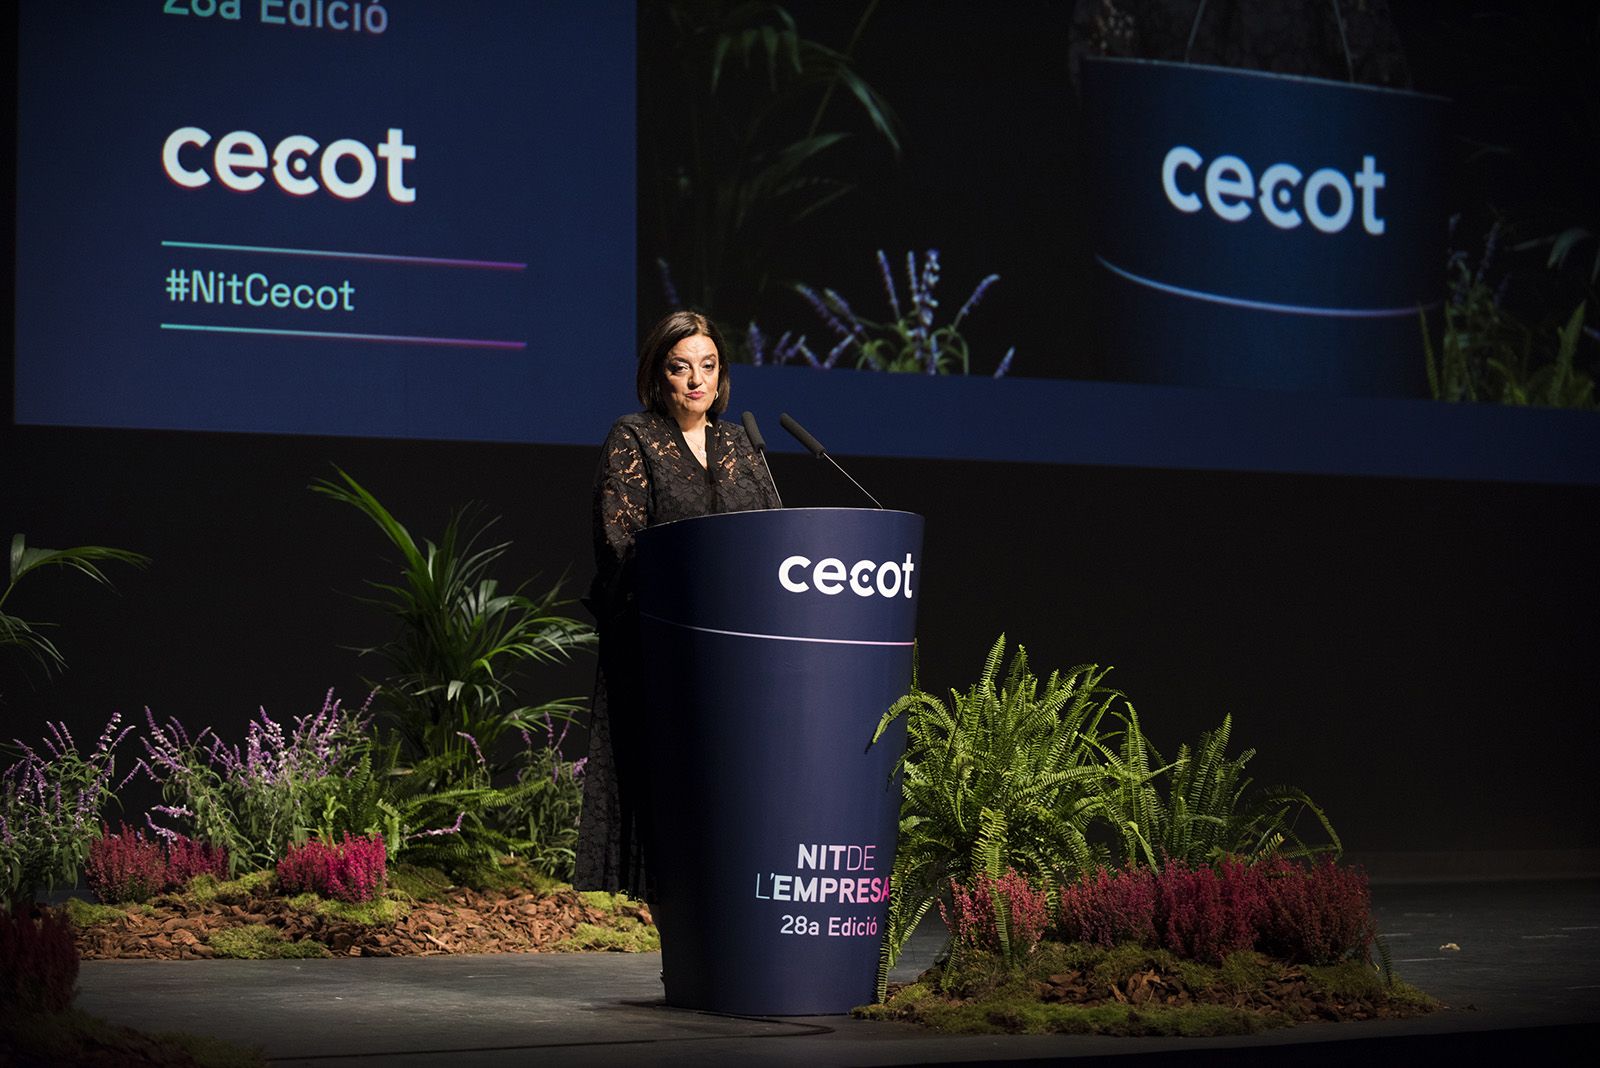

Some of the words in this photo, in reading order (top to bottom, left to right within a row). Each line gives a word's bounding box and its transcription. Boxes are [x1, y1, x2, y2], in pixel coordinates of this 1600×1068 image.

[162, 126, 417, 203] cecot
[1162, 146, 1385, 235] cecot
[165, 268, 356, 311] #NitCecot
[778, 553, 914, 599] cecot
[755, 873, 890, 903] L'EMPRESA
[780, 914, 820, 935] 28a
[828, 916, 878, 936] Edició
